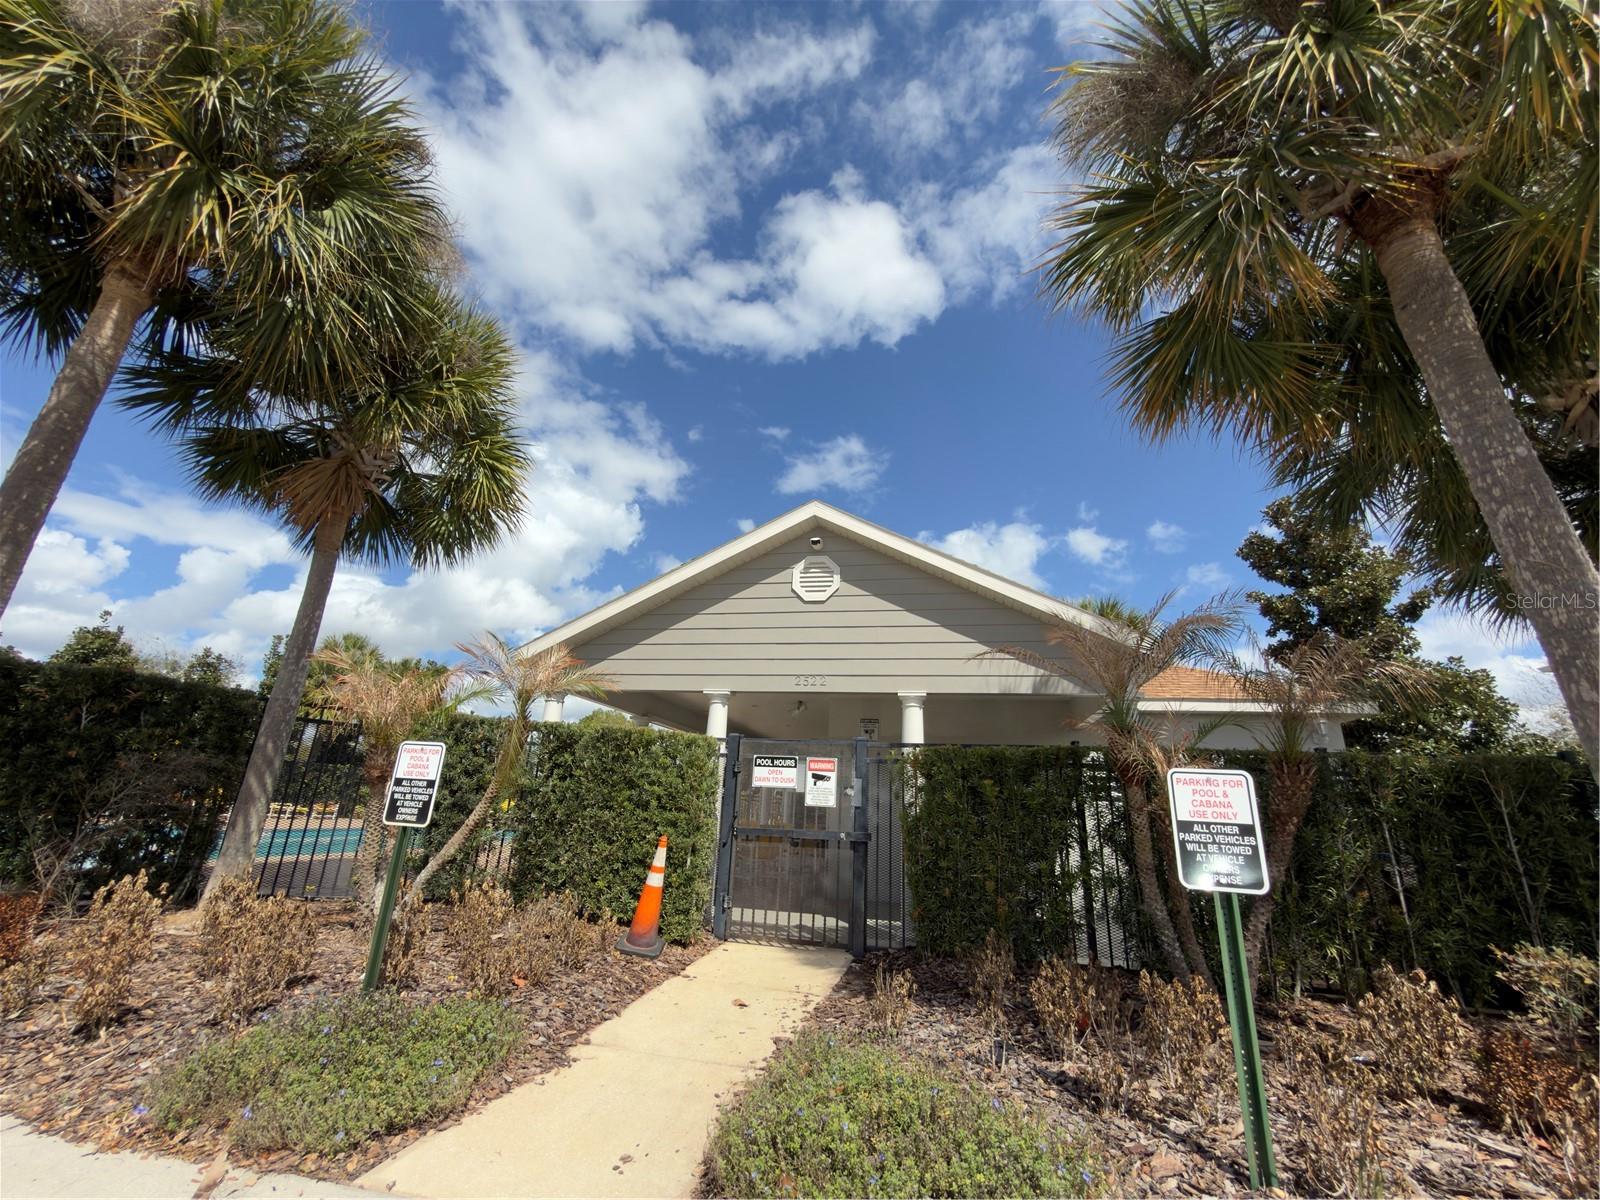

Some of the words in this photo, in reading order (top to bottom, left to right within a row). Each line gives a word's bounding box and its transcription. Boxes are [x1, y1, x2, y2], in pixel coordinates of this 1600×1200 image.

[795, 675, 826, 686] 2522
[1176, 778, 1219, 788] PARKING
[1222, 780, 1243, 788] FOR
[1192, 790, 1220, 798] POOL
[1192, 800, 1233, 809] CABANA
[1189, 810, 1208, 819] USE
[1211, 811, 1238, 820] ONLY
[1194, 824, 1208, 832] ALL
[1210, 825, 1239, 834] OTHER
[1179, 833, 1213, 842] PARKED
[1214, 836, 1256, 845] VEHICLES
[1186, 843, 1206, 852] WILL
[1208, 844, 1219, 852] BE
[1221, 845, 1252, 855] TOWED
[1196, 854, 1208, 862] AT
[1209, 855, 1244, 864] VEHICLE
[1203, 864, 1240, 874] OERS
[1206, 874, 1243, 884] PENSE
